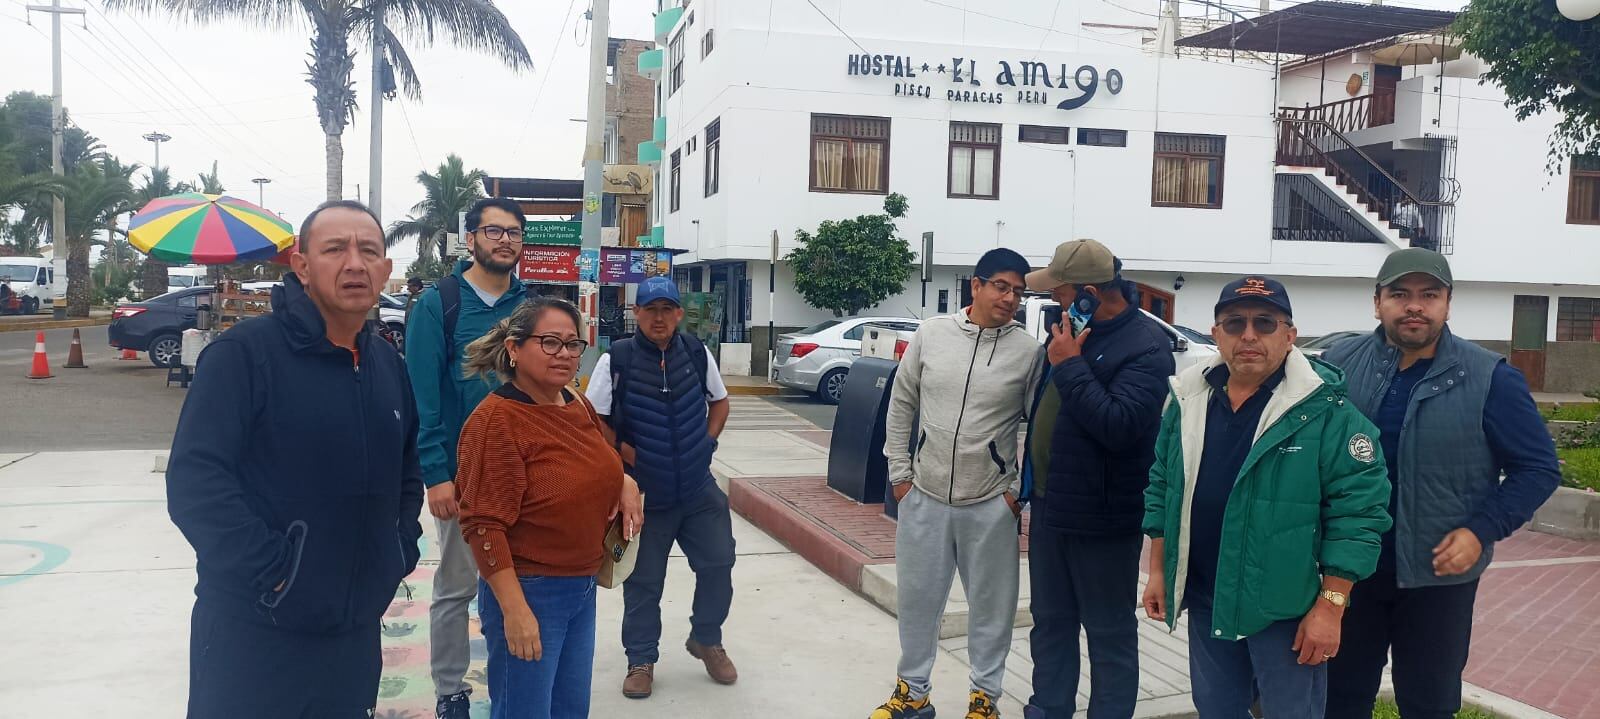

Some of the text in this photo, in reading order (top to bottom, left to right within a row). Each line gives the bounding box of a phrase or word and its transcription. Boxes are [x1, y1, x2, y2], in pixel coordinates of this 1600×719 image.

[848, 54, 916, 78] HOSTAL
[952, 57, 981, 87] EL
[894, 83, 1047, 105] PISCO PARACAS PERU
